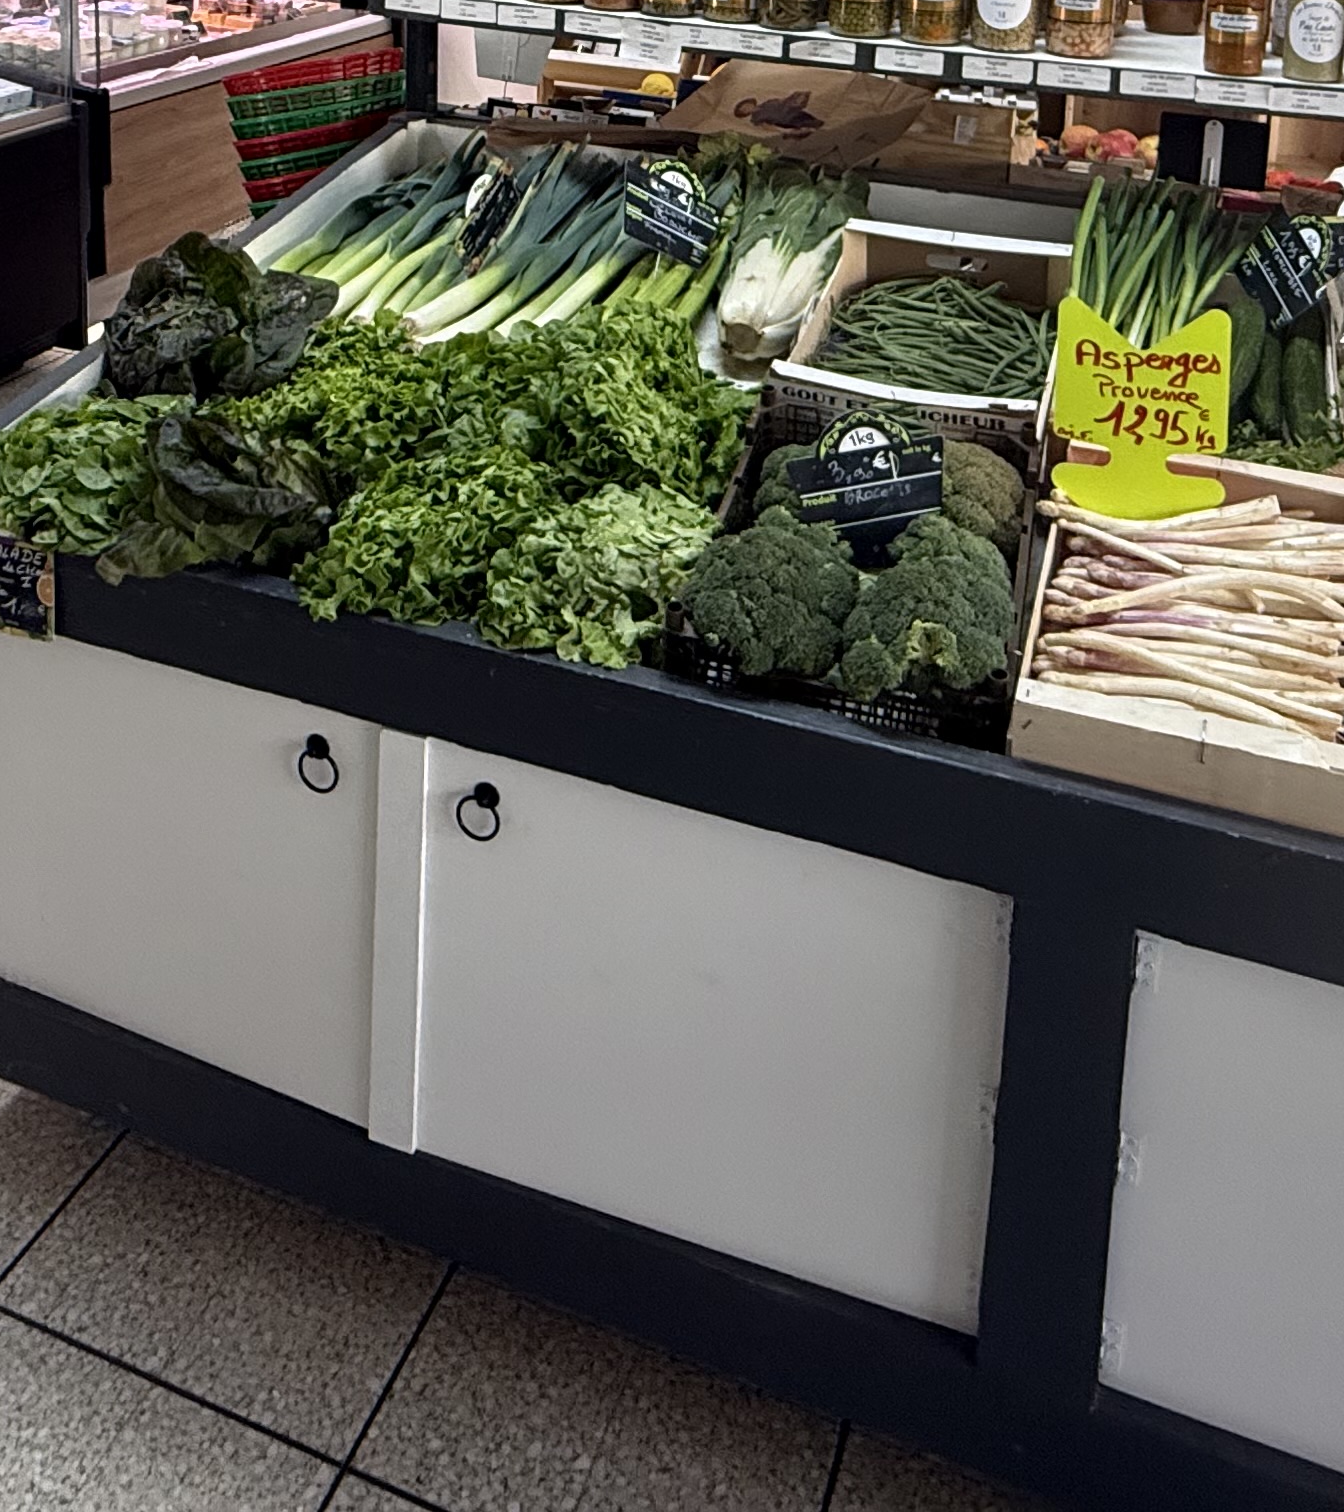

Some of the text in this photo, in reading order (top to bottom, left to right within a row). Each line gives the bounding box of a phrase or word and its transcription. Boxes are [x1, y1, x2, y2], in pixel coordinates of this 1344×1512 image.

[1075, 339, 1222, 388] Asperges
[1093, 373, 1204, 410] Provence
[919, 410, 1006, 431] ICHEUR
[849, 430, 875, 447] 1kg
[802, 494, 838, 507] Produit
